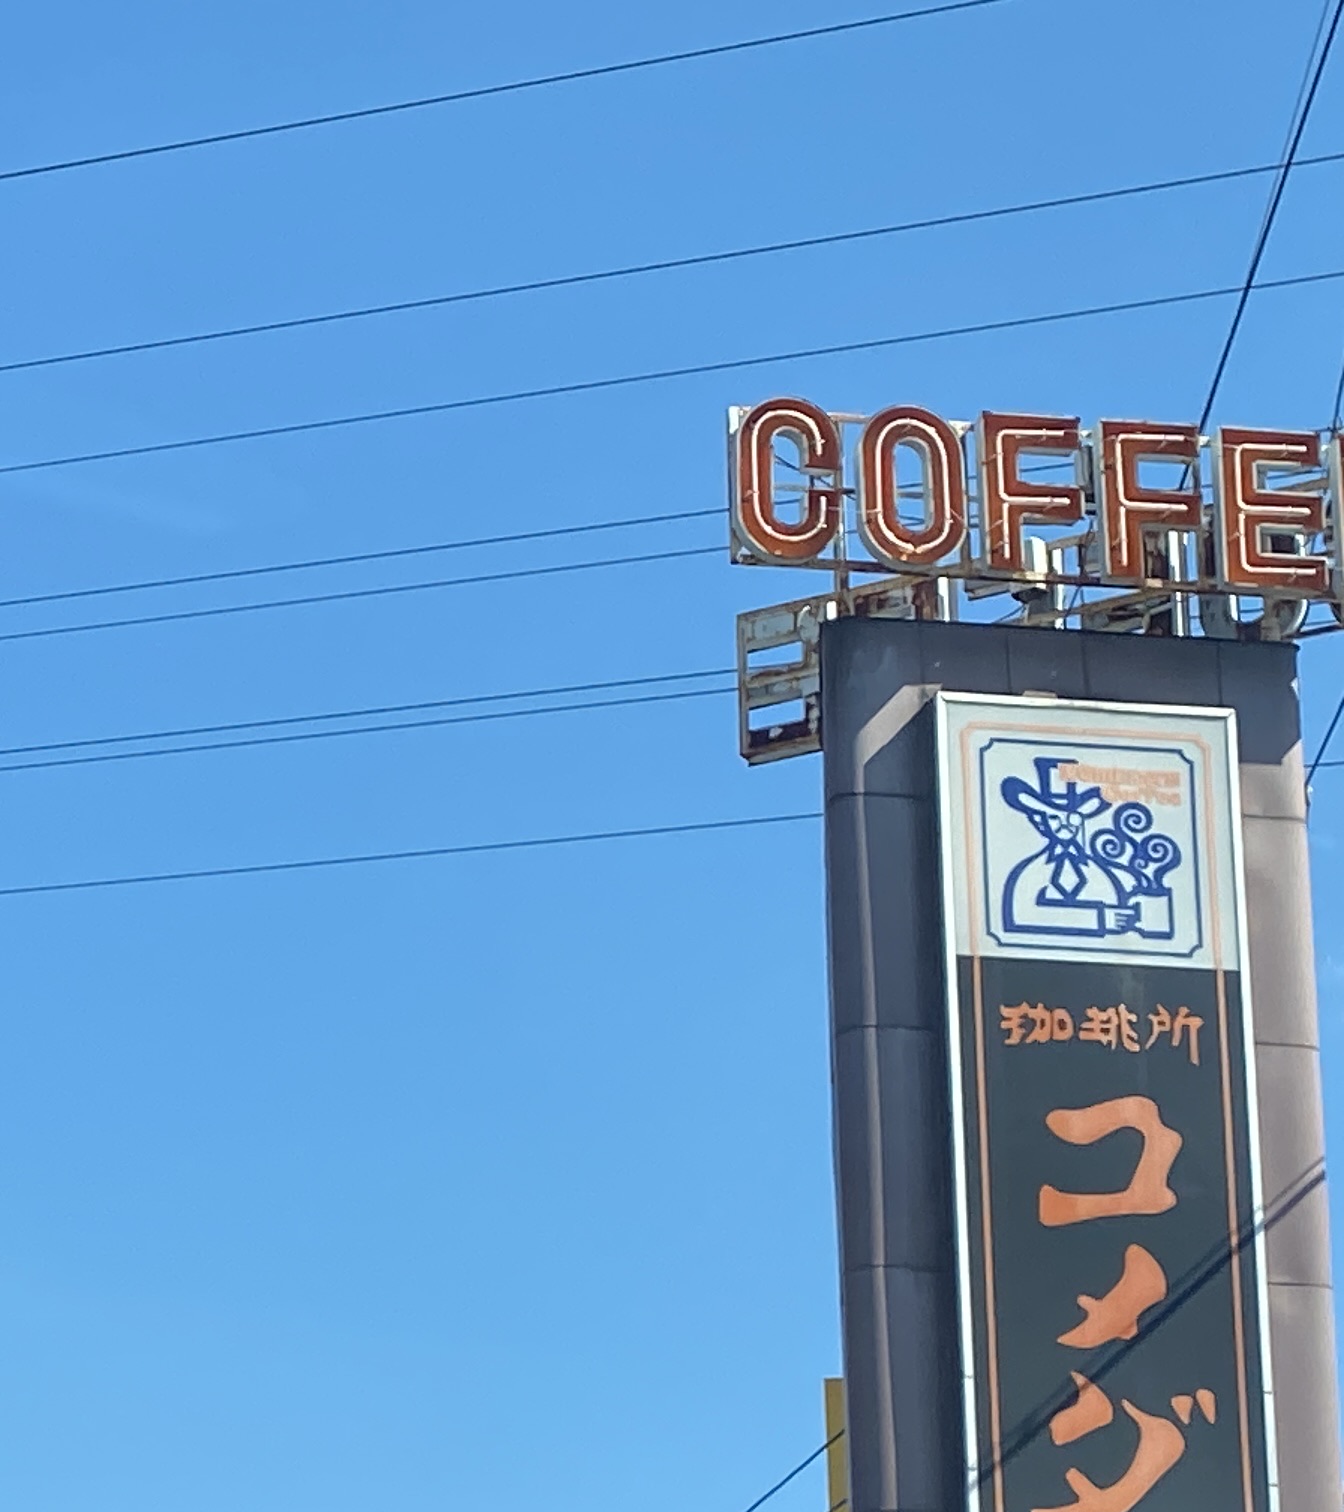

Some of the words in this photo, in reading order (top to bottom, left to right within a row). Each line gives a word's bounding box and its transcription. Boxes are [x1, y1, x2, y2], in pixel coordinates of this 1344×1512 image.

[729, 396, 1344, 599] COFFE
[999, 1001, 1206, 1067] 珈琲所
